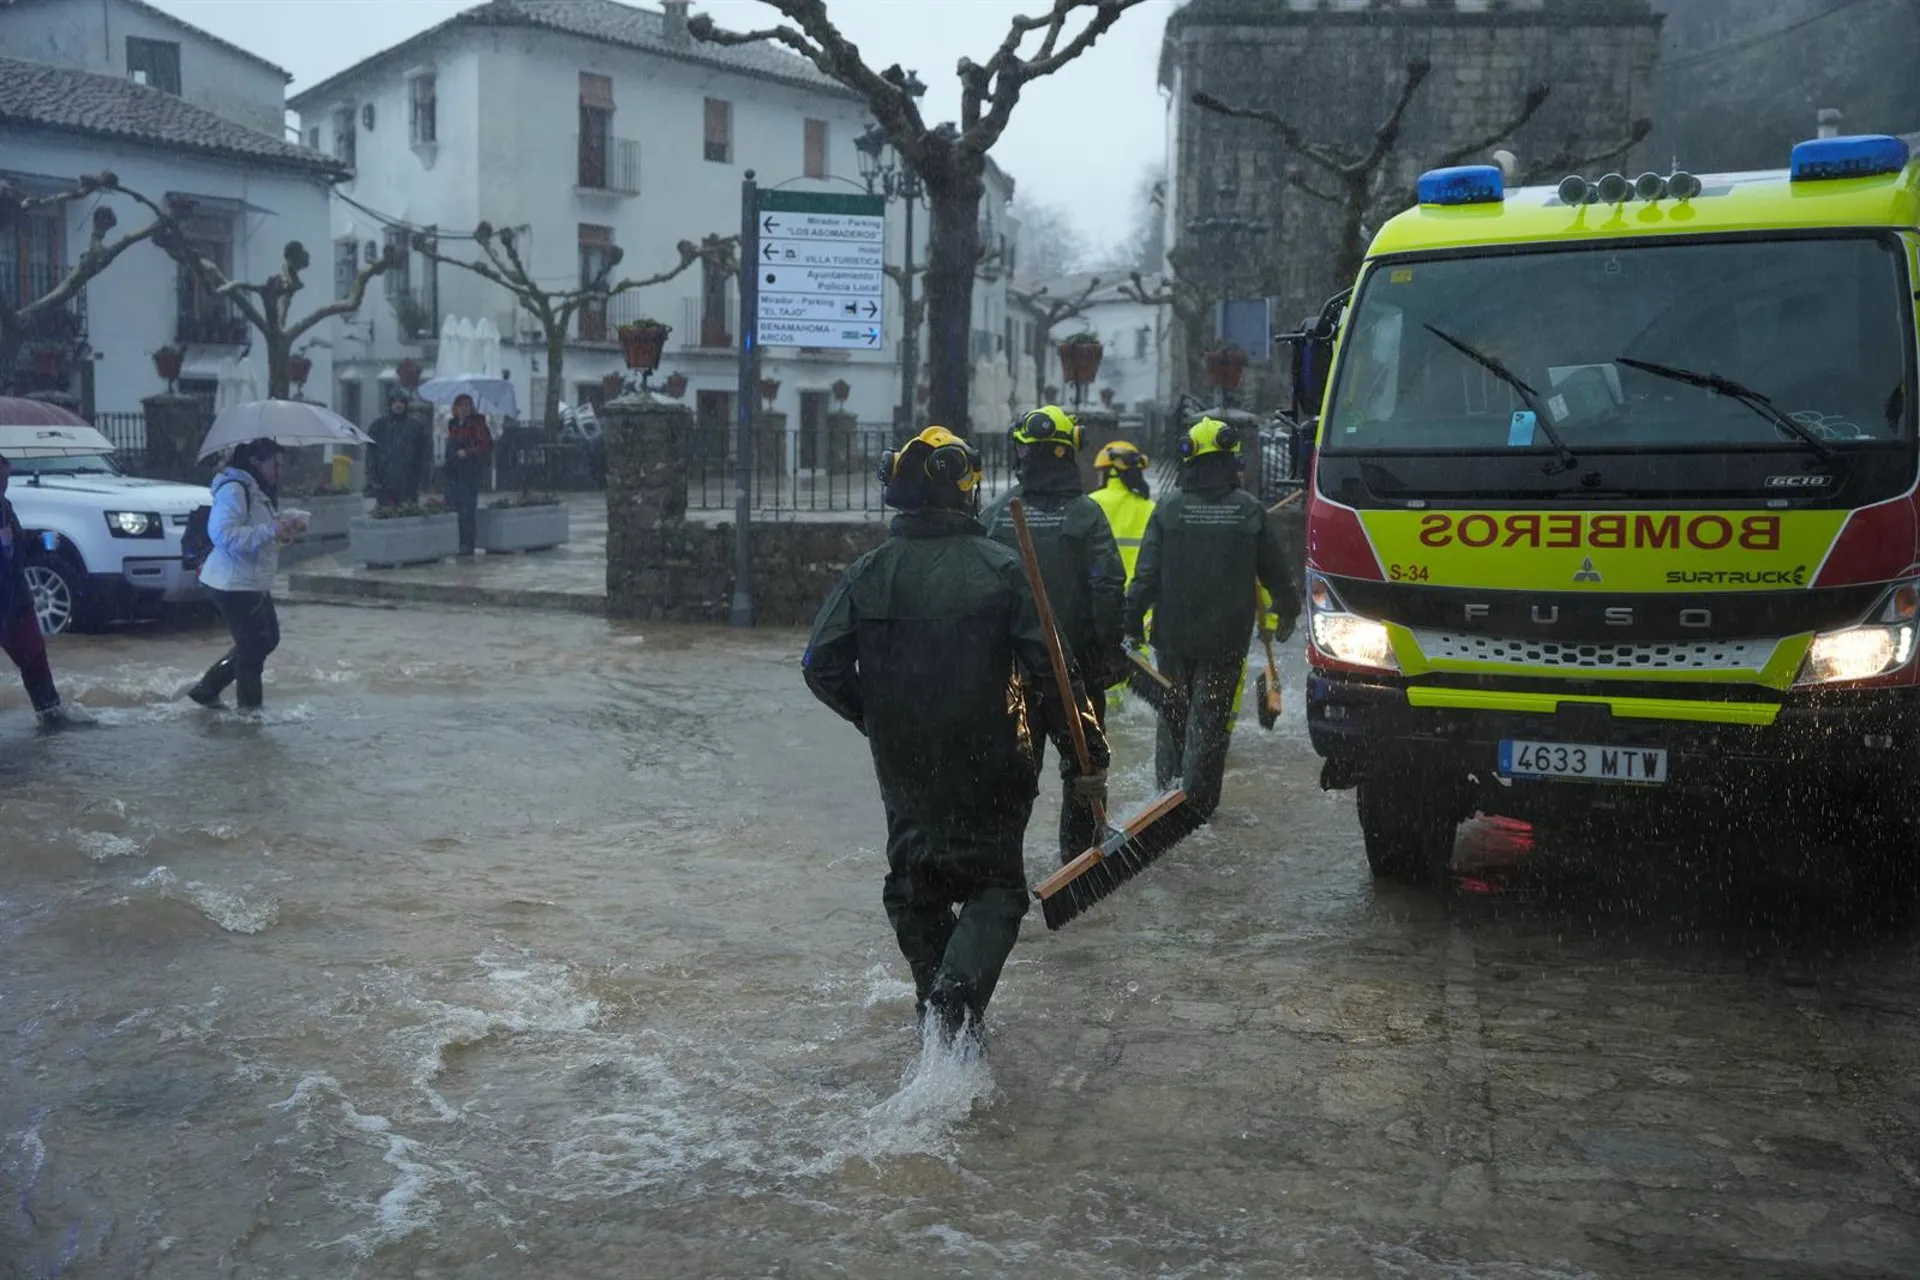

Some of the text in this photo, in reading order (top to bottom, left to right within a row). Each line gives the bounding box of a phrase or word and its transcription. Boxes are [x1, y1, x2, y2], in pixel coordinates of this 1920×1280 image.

[805, 256, 833, 264] VILLA
[807, 270, 873, 281] Ayuntamiento
[853, 283, 880, 291] Local
[760, 322, 830, 333] BENAMAHOMA
[760, 333, 794, 343] ARCOS
[1390, 563, 1430, 582] S-34
[1666, 571, 1793, 584] SURTRUCK
[1464, 602, 1713, 628] FUSO
[1517, 744, 1659, 778] 4633 MTW
